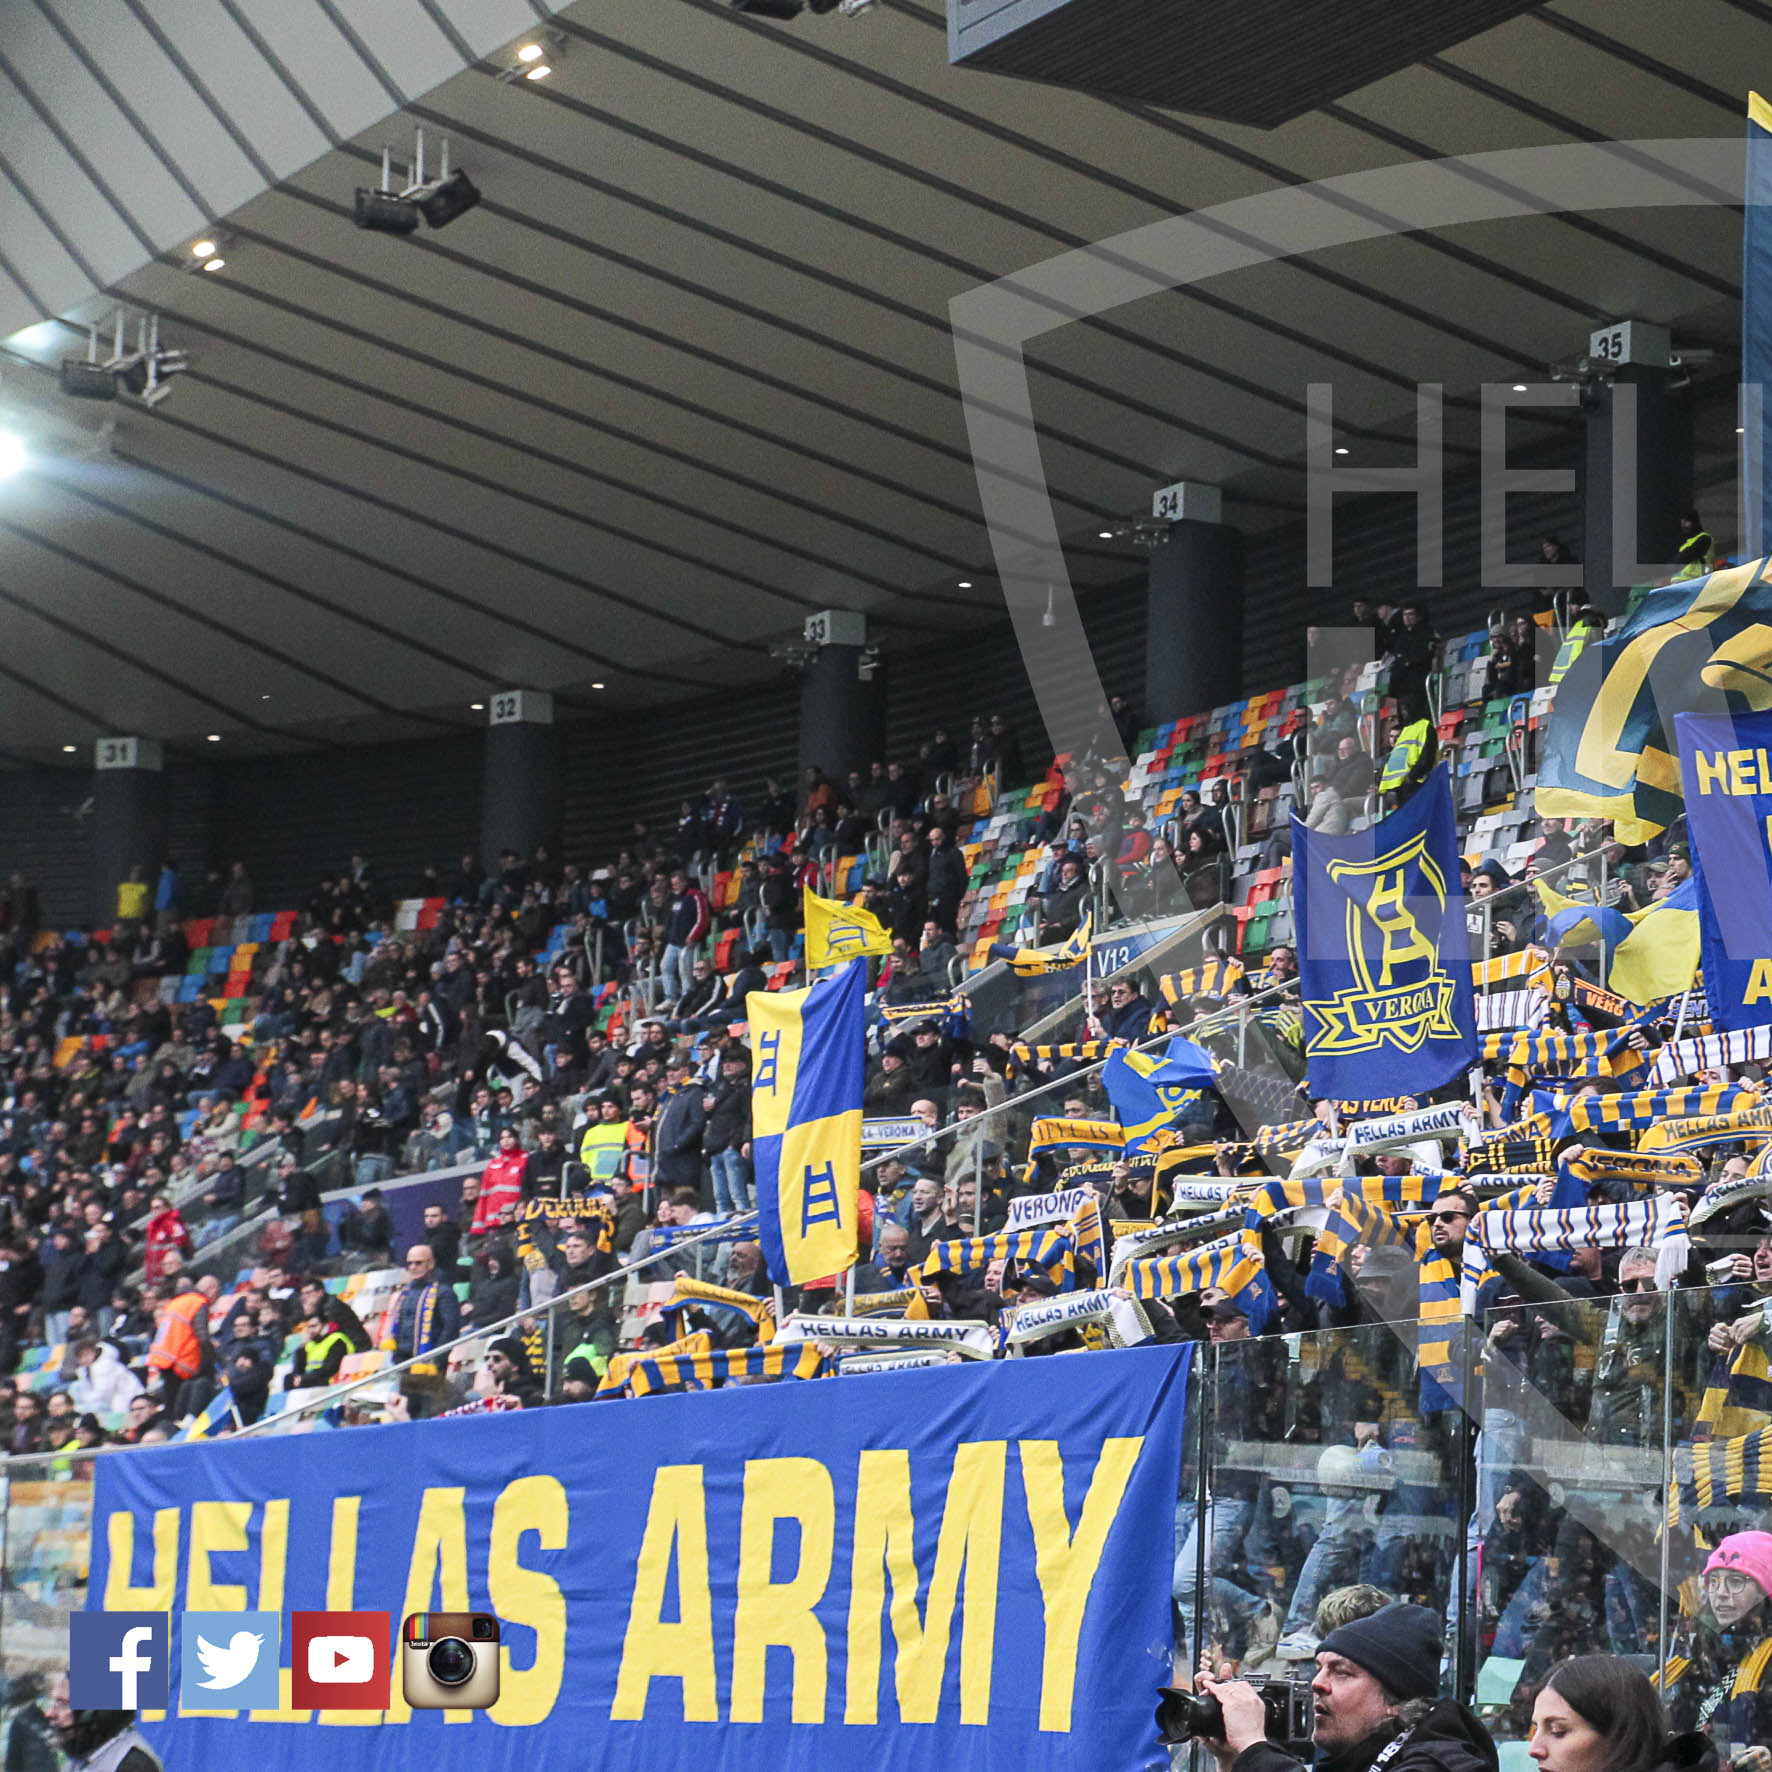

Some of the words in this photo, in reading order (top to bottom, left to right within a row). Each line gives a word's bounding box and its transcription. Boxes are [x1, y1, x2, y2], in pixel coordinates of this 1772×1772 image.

[1597, 331, 1621, 361] 35
[1157, 491, 1178, 519] 34
[808, 617, 825, 642] 33
[496, 698, 516, 721] 32
[105, 741, 131, 763] 31
[1098, 946, 1129, 979] V13
[1355, 1120, 1407, 1145] HELLAS
[1411, 1109, 1462, 1137] ARMY
[1663, 1119, 1729, 1142] HELLAS
[1013, 1190, 1085, 1224] VERONA
[1180, 1185, 1222, 1201] HELLAS
[1016, 1306, 1063, 1333] HELLAS
[1068, 1293, 1113, 1318] ARMY
[801, 1323, 888, 1340] HELLAS
[897, 1325, 967, 1343] ARMY
[610, 1436, 1145, 1733] ARMY
